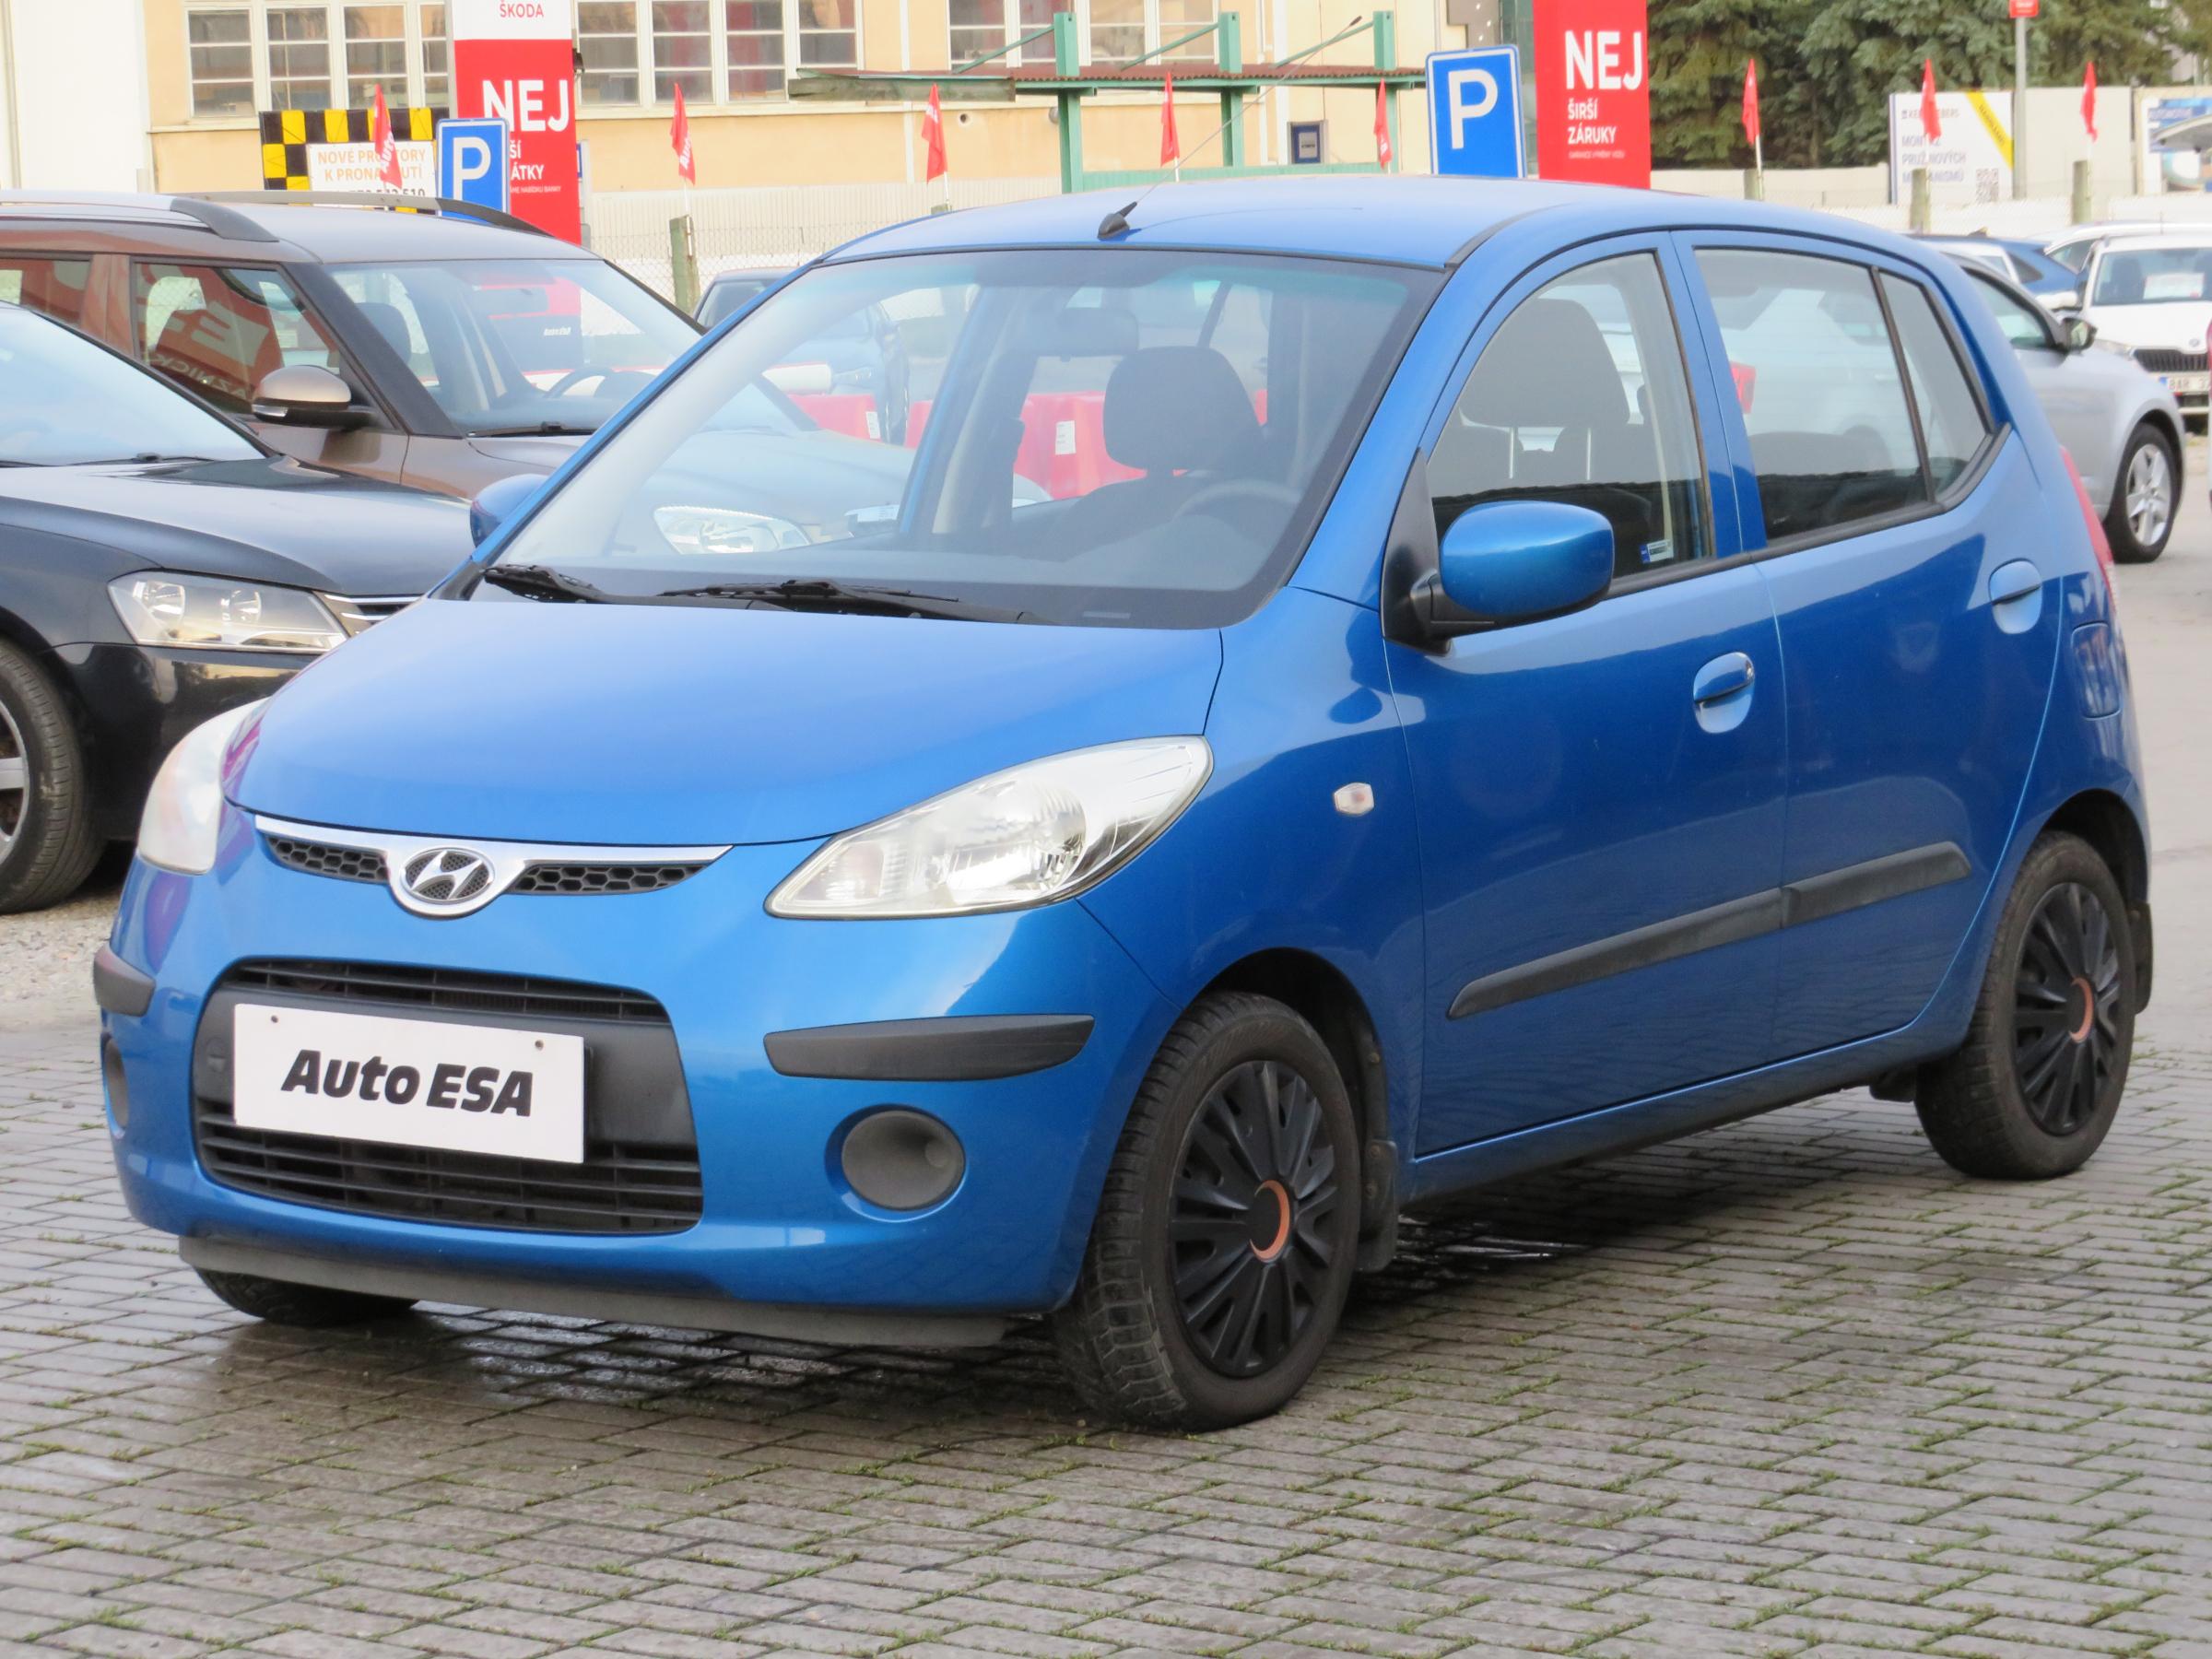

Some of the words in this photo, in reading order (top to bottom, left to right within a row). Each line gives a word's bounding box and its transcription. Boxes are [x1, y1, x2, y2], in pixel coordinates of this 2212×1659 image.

[500, 0, 545, 18] ŠKODA
[1565, 29, 1642, 90] NEJ
[482, 79, 569, 132] NEJ
[1448, 68, 1498, 149] P
[1568, 98, 1598, 120] ŠIRŠÍ
[1568, 122, 1617, 145] ZÁRUKY
[317, 148, 355, 164] NOVÉ
[324, 169, 333, 182] K
[453, 136, 491, 200] P
[511, 161, 545, 181] ÁTKY
[280, 1049, 420, 1105] Auto
[426, 1063, 534, 1117] ESA
